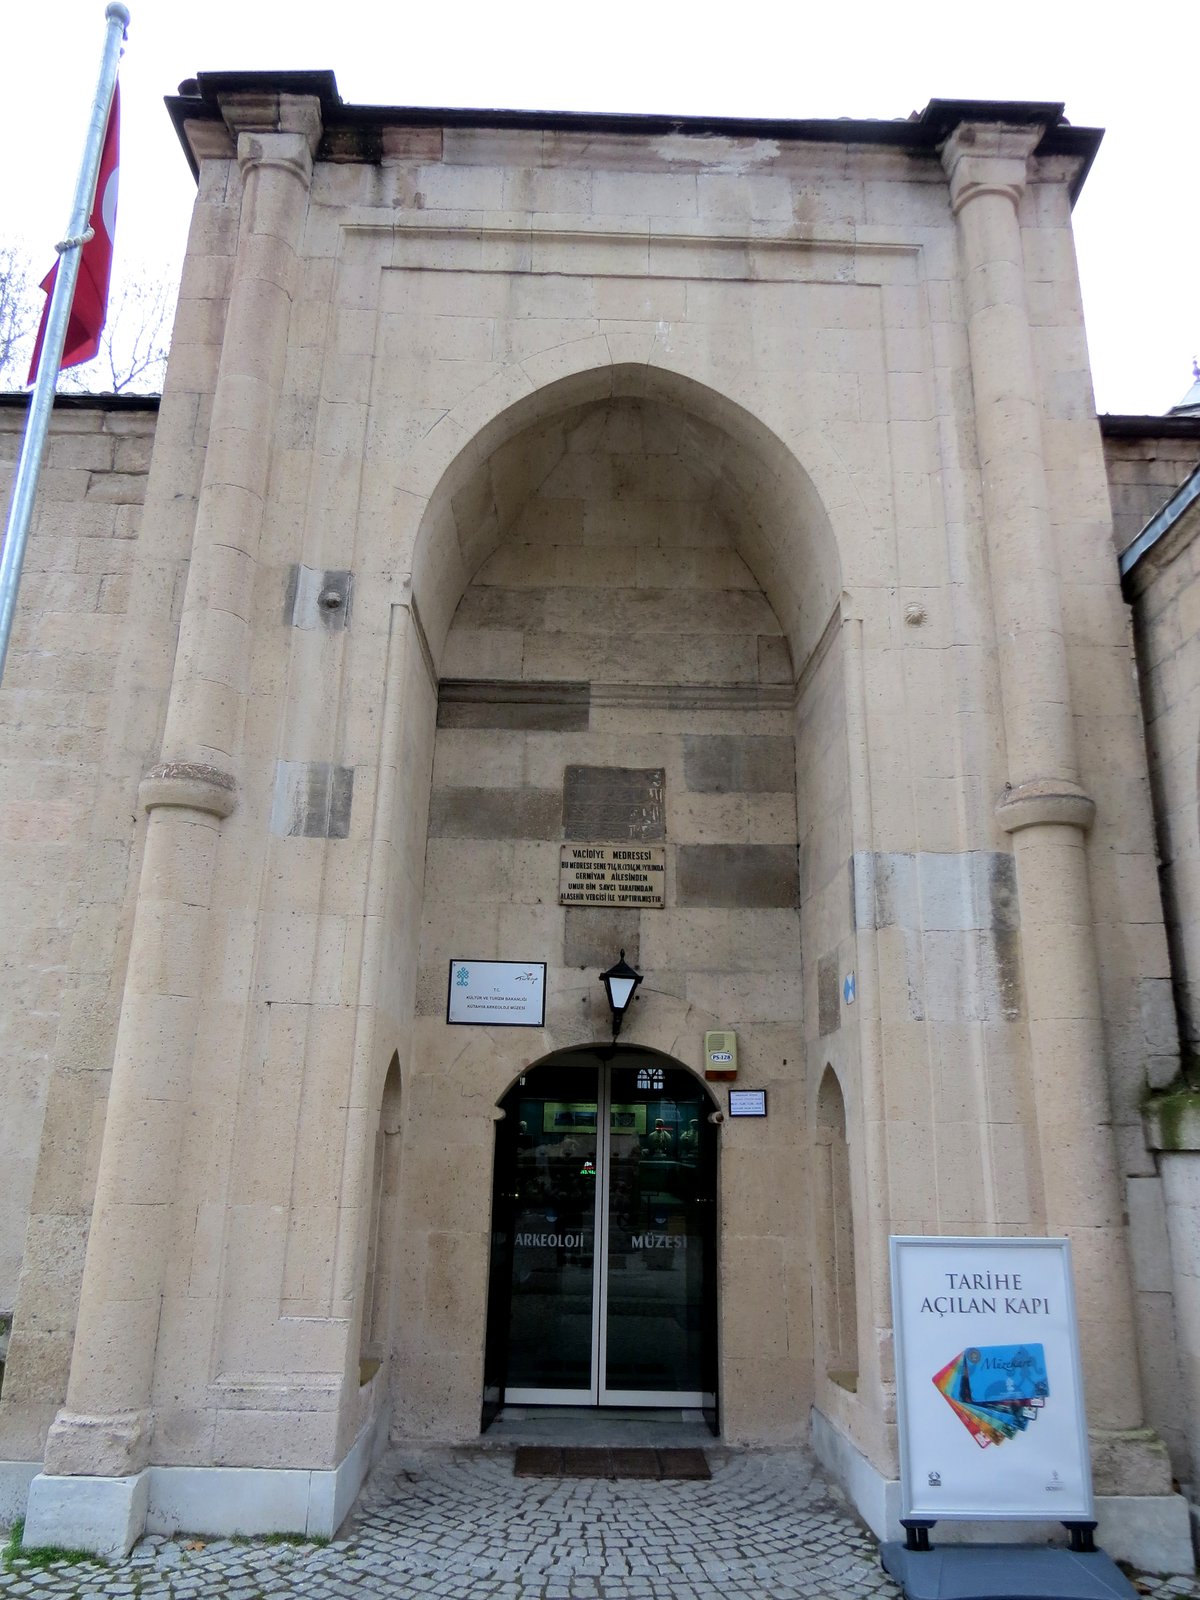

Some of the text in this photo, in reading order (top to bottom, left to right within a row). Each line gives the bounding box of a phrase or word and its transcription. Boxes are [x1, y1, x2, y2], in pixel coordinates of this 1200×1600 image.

[572, 849, 651, 860] VACİDİYE MEDRESESİ
[576, 872, 648, 881] GERMİYAN AİLESİNDEN
[586, 882, 596, 890] BİN
[514, 1232, 687, 1248] ARKEOLOJİ MÜZESİ
[945, 1271, 1022, 1290] TARİHE
[920, 1297, 1050, 1318] AÇILAN KAPI
